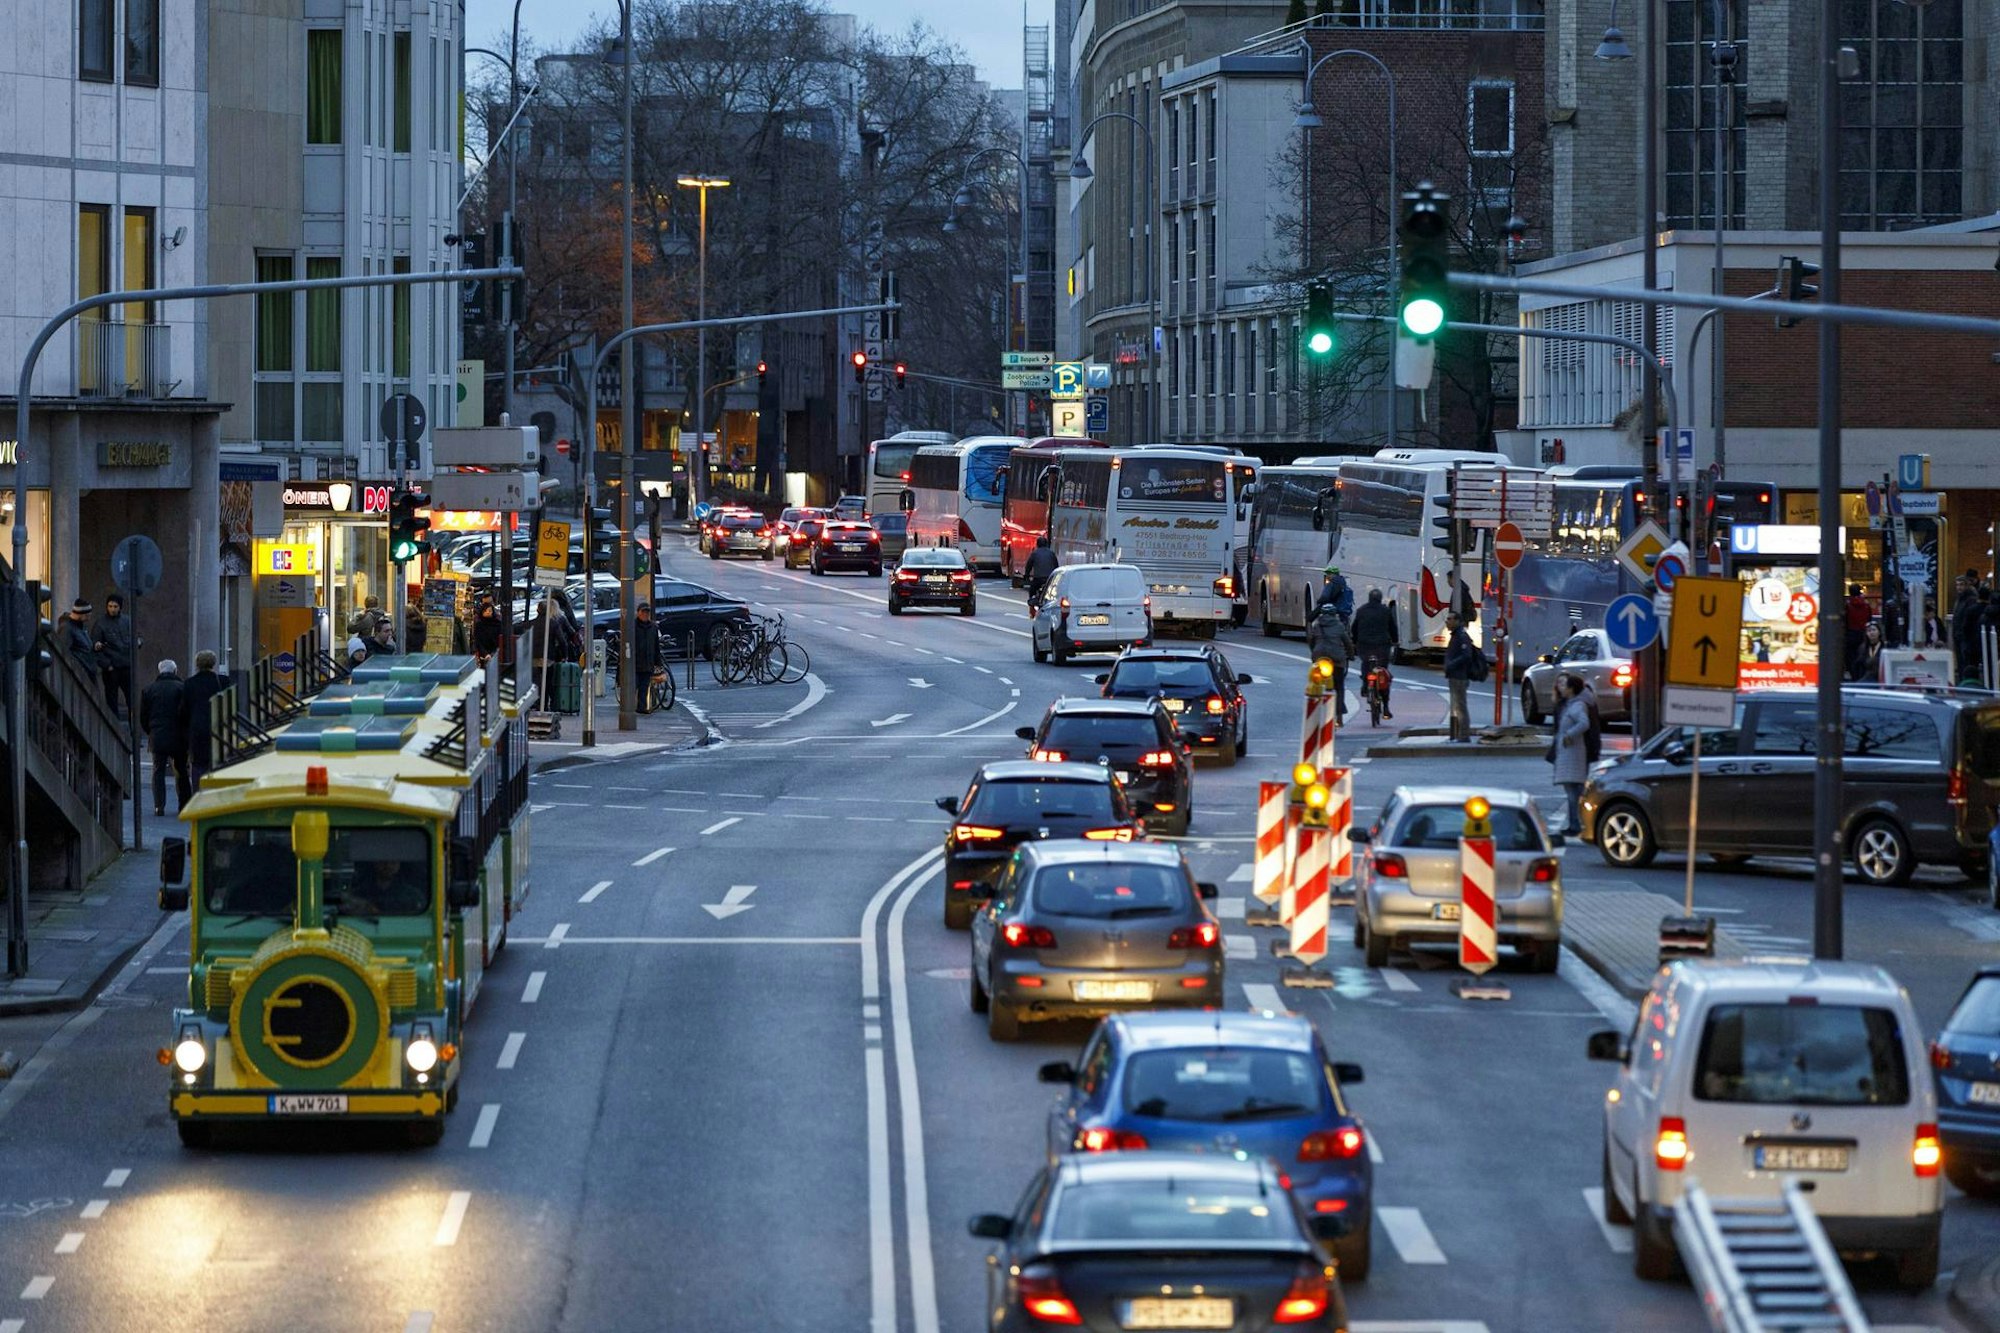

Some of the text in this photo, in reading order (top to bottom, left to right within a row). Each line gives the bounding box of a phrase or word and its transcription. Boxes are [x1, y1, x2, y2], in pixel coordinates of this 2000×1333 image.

[1006, 373, 1041, 381] Zoobrücke
[1060, 370, 1076, 391] P
[1092, 403, 1102, 415] P
[1062, 411, 1075, 427] P
[1904, 459, 1919, 485] U
[1735, 527, 1756, 551] U
[1699, 595, 1717, 617] U
[280, 1097, 340, 1110] K WW 701
